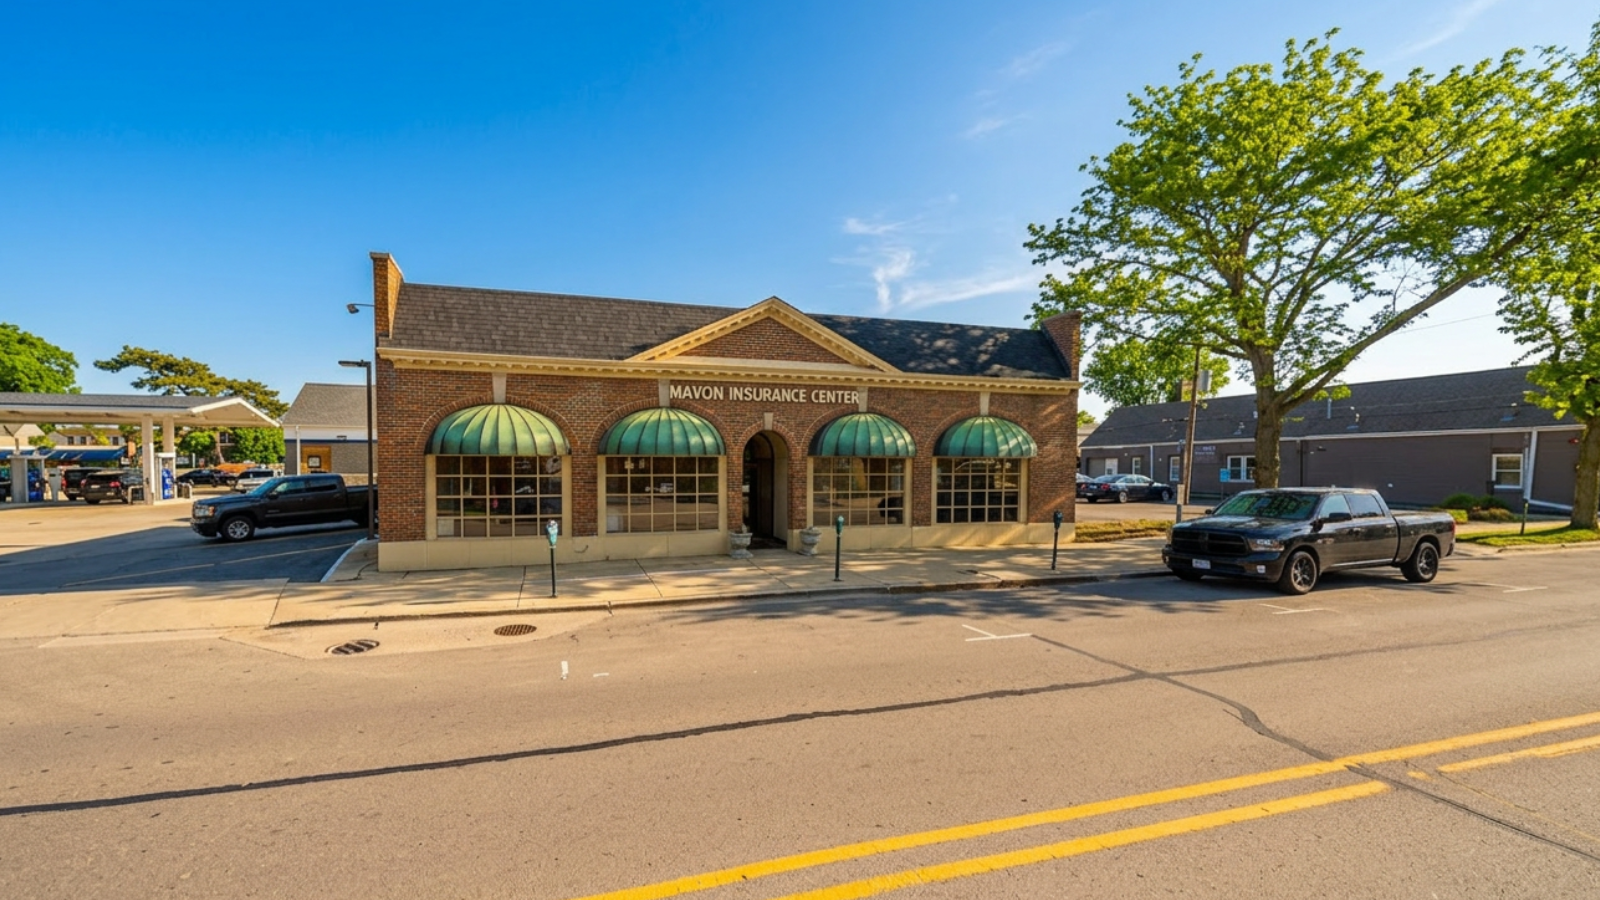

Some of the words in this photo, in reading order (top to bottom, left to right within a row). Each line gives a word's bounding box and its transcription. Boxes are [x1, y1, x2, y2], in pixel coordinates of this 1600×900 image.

[669, 385, 724, 400] MAVON
[729, 387, 806, 403] INSURANCE
[811, 389, 860, 404] CENTER
